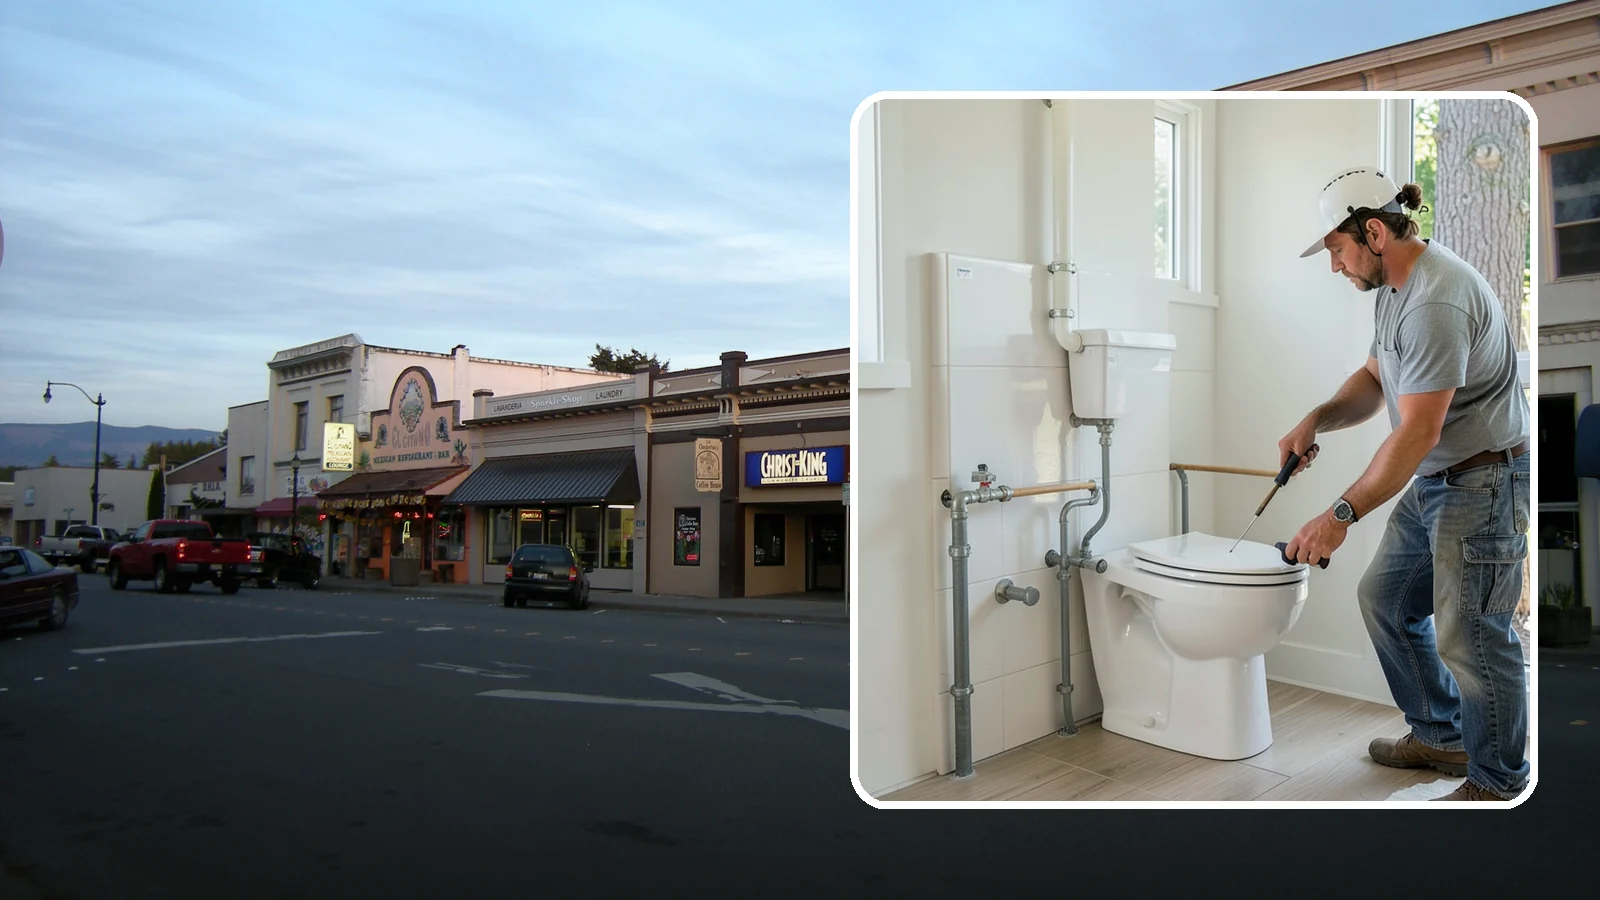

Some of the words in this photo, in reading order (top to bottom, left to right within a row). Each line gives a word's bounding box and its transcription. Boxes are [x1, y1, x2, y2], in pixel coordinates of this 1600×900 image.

[595, 389, 623, 400] LAUNDRY
[493, 402, 523, 412] LAVANDERIA
[530, 396, 559, 409] Sparkle
[562, 394, 582, 405] Shop
[373, 454, 396, 464] MEXICAN
[397, 451, 433, 462] RESTAURANT
[437, 450, 450, 459] BAR
[760, 452, 797, 478] CHRIST
[799, 449, 827, 476] KING
[697, 481, 709, 489] Coffee
[709, 481, 722, 489] House
